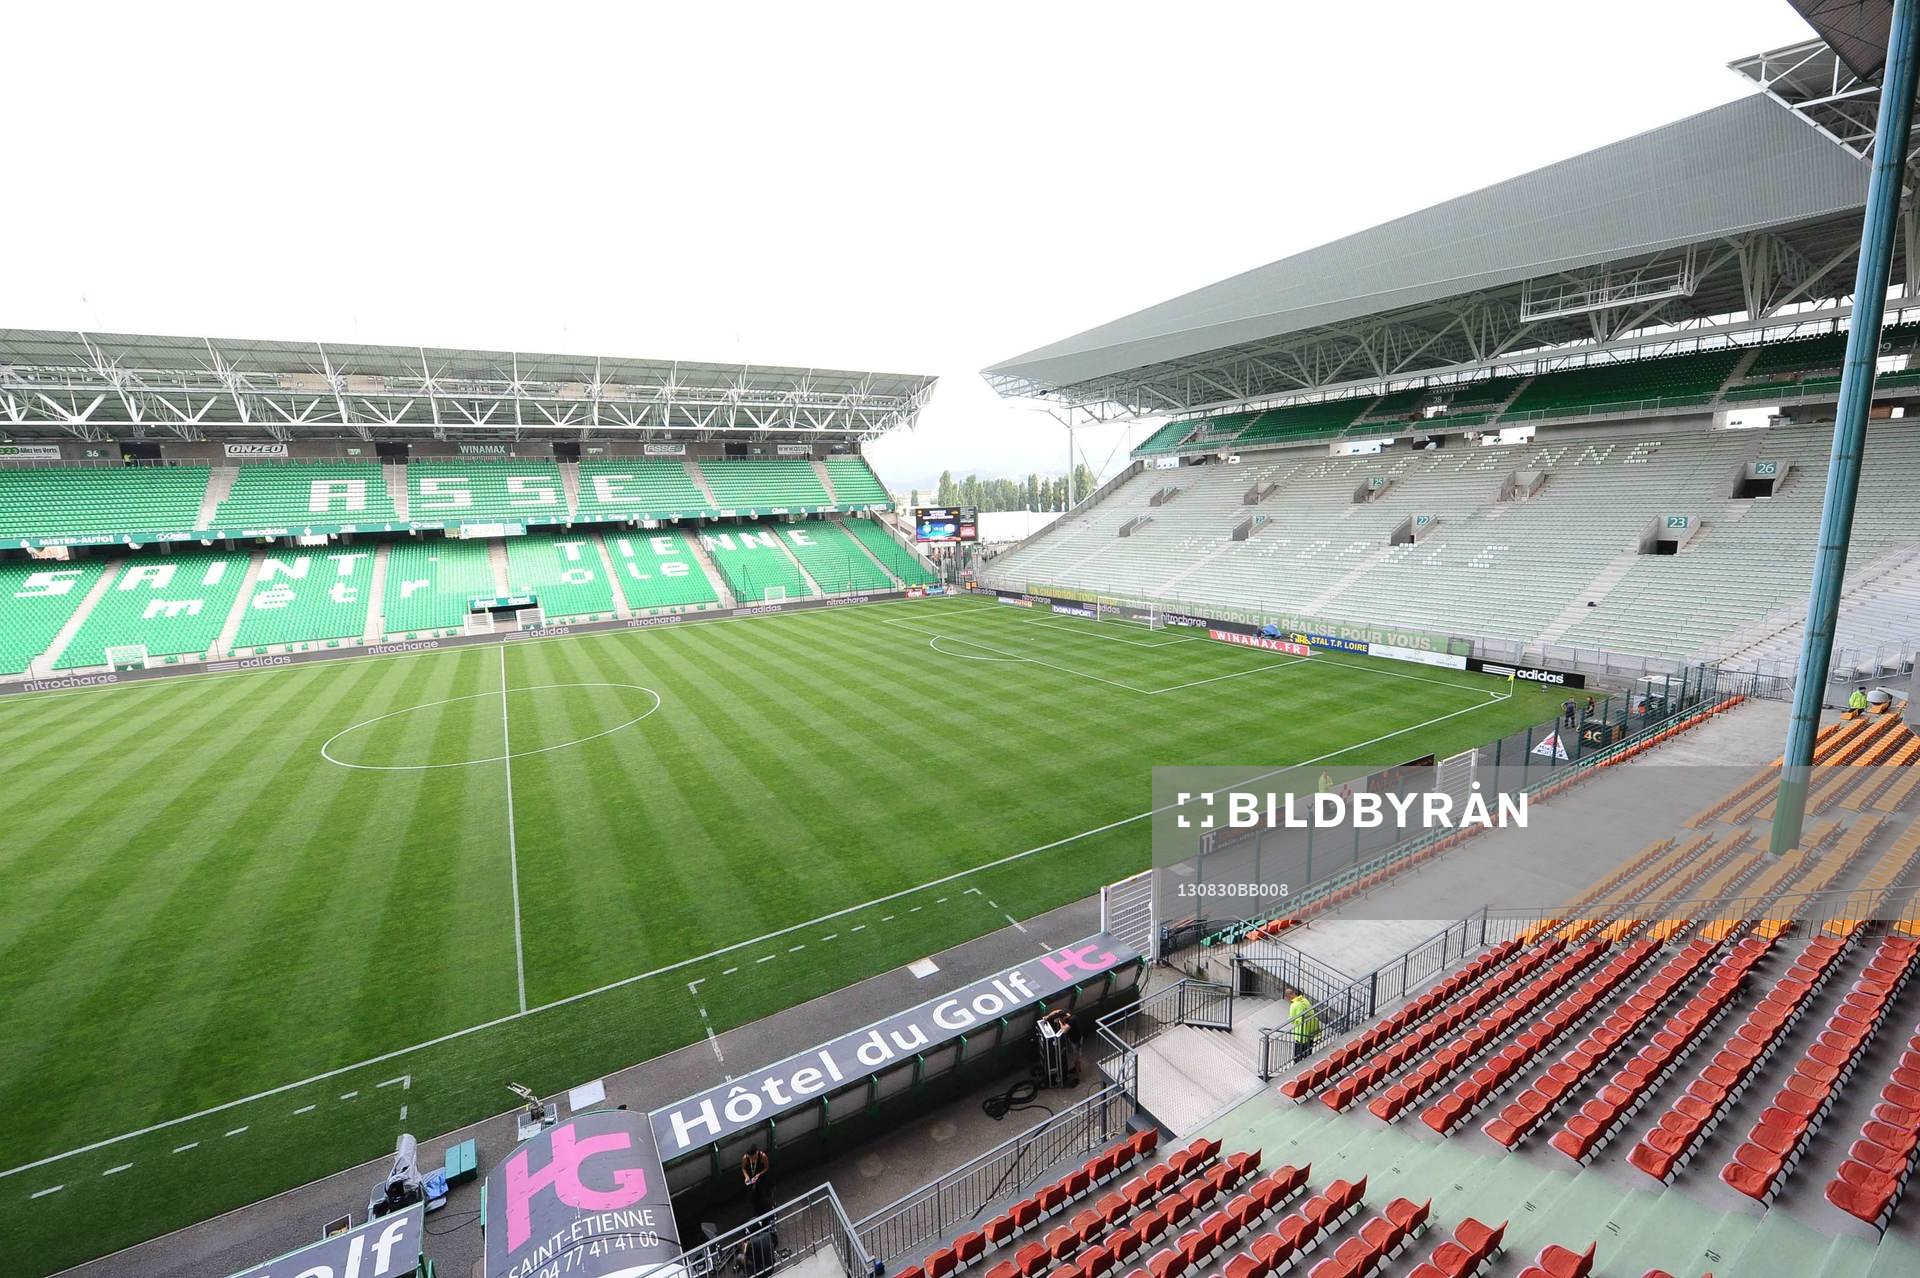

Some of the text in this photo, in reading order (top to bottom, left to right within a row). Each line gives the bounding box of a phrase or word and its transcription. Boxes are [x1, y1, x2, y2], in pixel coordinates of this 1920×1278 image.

[86, 450, 99, 458] 36
[230, 445, 282, 453] ONZEO
[460, 445, 506, 454] WINAMAX
[1757, 463, 1775, 474] 26
[308, 475, 641, 512] ASSE
[1669, 517, 1686, 528] 23
[554, 530, 817, 562] TIENNE
[826, 595, 869, 606] nitrocharge
[752, 604, 782, 615] adidas
[627, 614, 682, 627] nitrocharge
[1160, 612, 1207, 628] nitrocharge
[530, 626, 570, 638] adidas
[1282, 613, 1337, 638] RÉALISE
[1341, 628, 1382, 645] POUR
[367, 639, 439, 655] nitrocharge
[1216, 630, 1301, 655] WINAMAX.FR
[1344, 642, 1368, 652] LOIRE
[240, 654, 291, 669] adidas
[24, 673, 118, 693] nitrocharge
[1516, 669, 1565, 684] adidas
[669, 1050, 844, 1149] Hôtel
[856, 1020, 929, 1067] du
[931, 970, 1035, 1031] Golf
[564, 1245, 585, 1273] 77
[588, 1239, 609, 1258] 41
[615, 1234, 634, 1251] 41
[638, 1230, 660, 1248] 00
